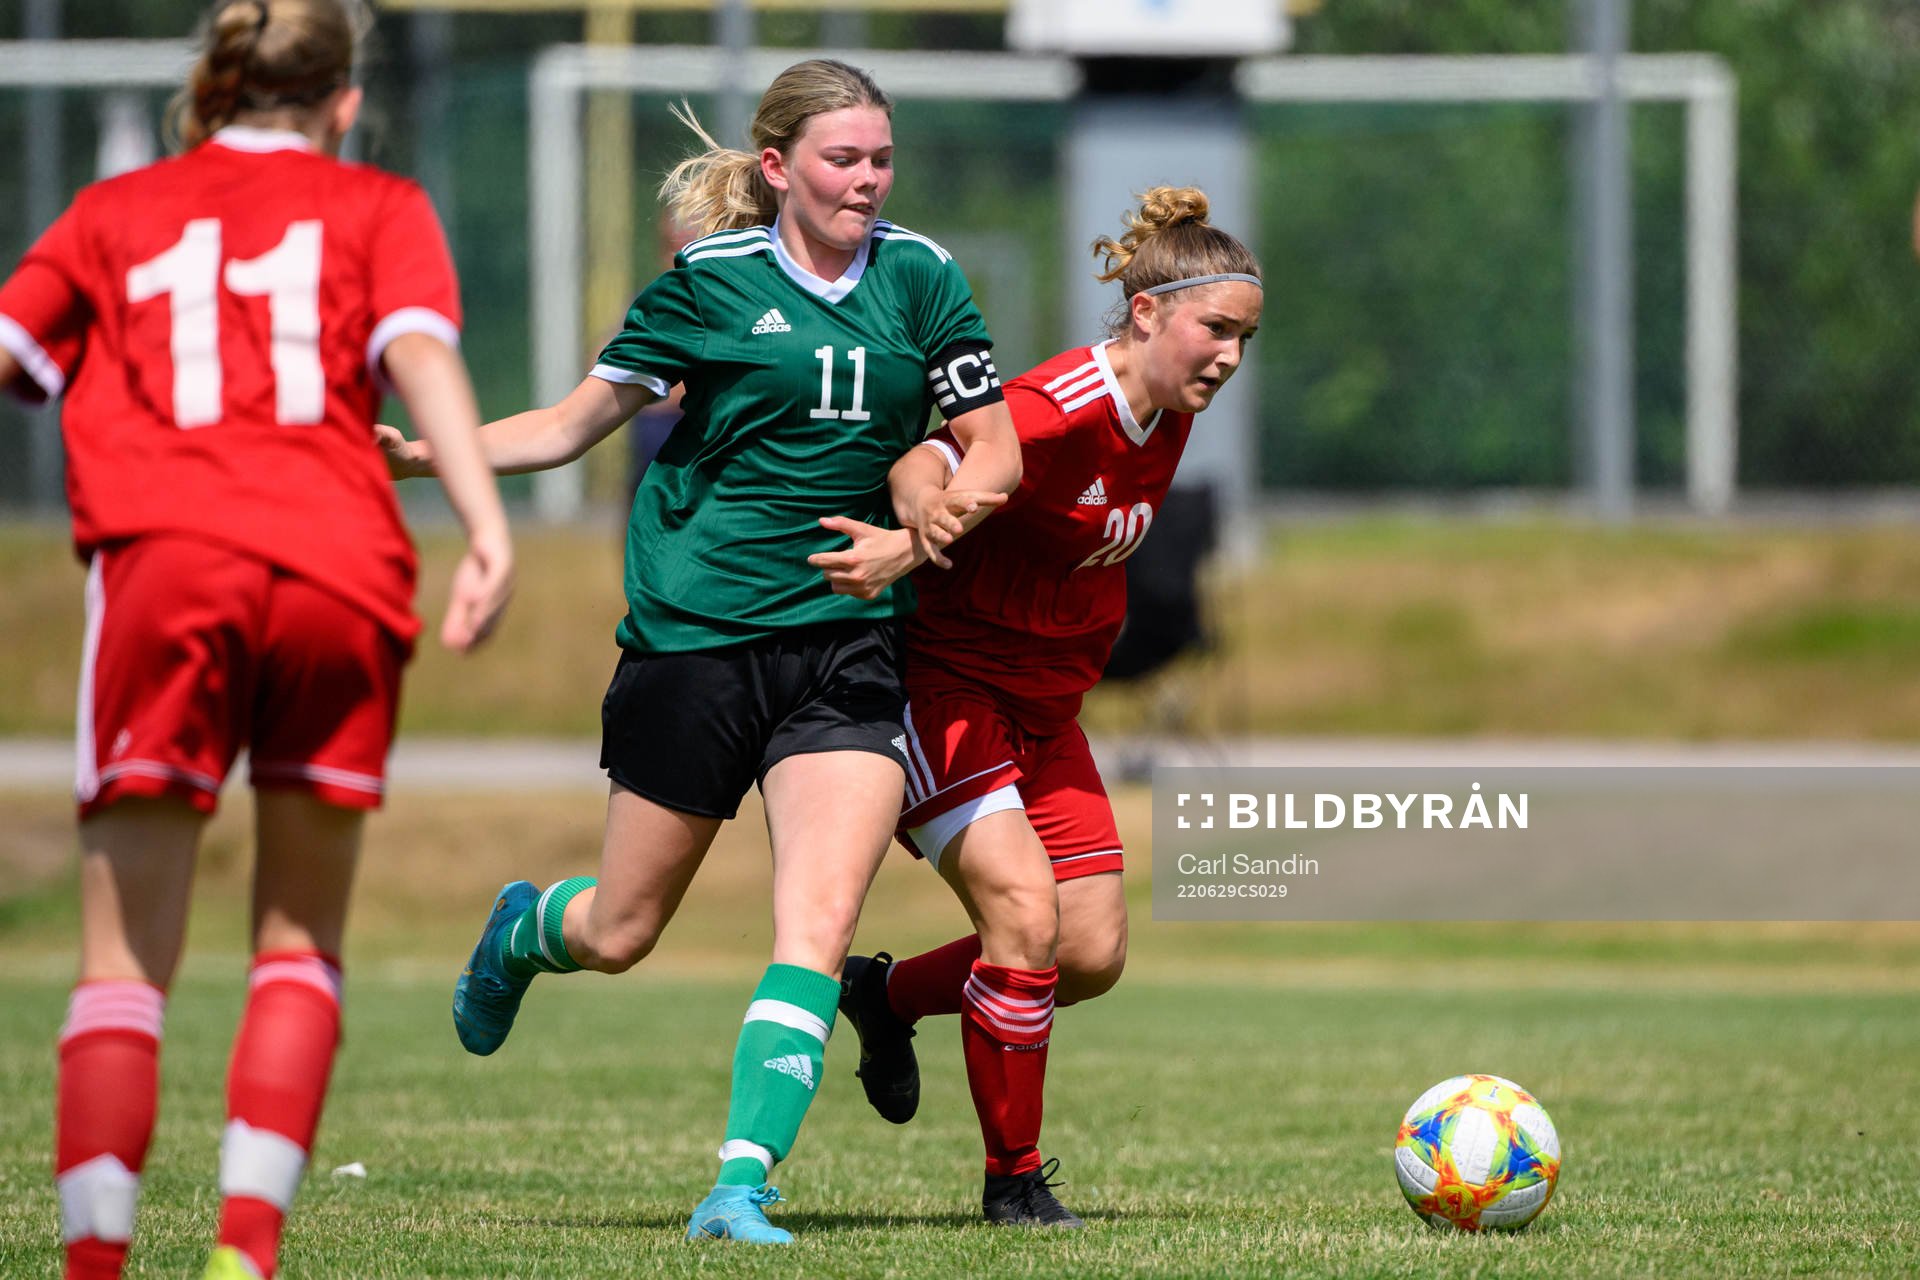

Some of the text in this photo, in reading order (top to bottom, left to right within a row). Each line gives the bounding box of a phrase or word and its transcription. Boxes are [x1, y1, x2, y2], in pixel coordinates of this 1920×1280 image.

[126, 217, 326, 430] 11
[752, 323, 792, 335] adidas
[809, 345, 871, 421] 11
[947, 353, 989, 398] C
[1077, 495, 1108, 506] adidas
[1072, 502, 1153, 572] 20
[763, 1059, 815, 1090] adidas
